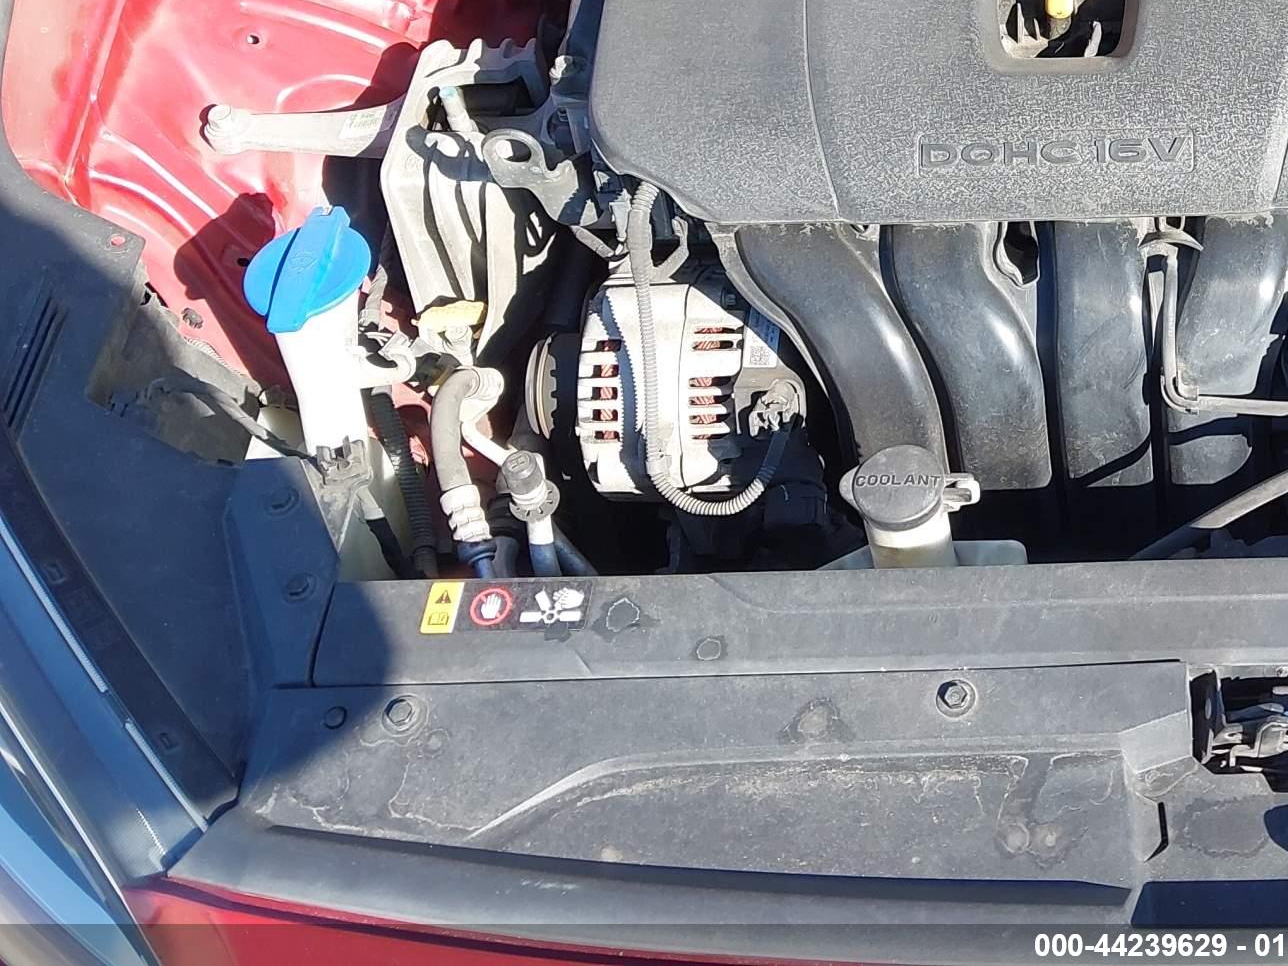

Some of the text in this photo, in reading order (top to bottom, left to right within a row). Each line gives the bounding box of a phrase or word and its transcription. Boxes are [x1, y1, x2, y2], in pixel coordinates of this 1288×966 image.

[920, 137, 1187, 168] DOHC 16V
[855, 474, 941, 487] COOLANT
